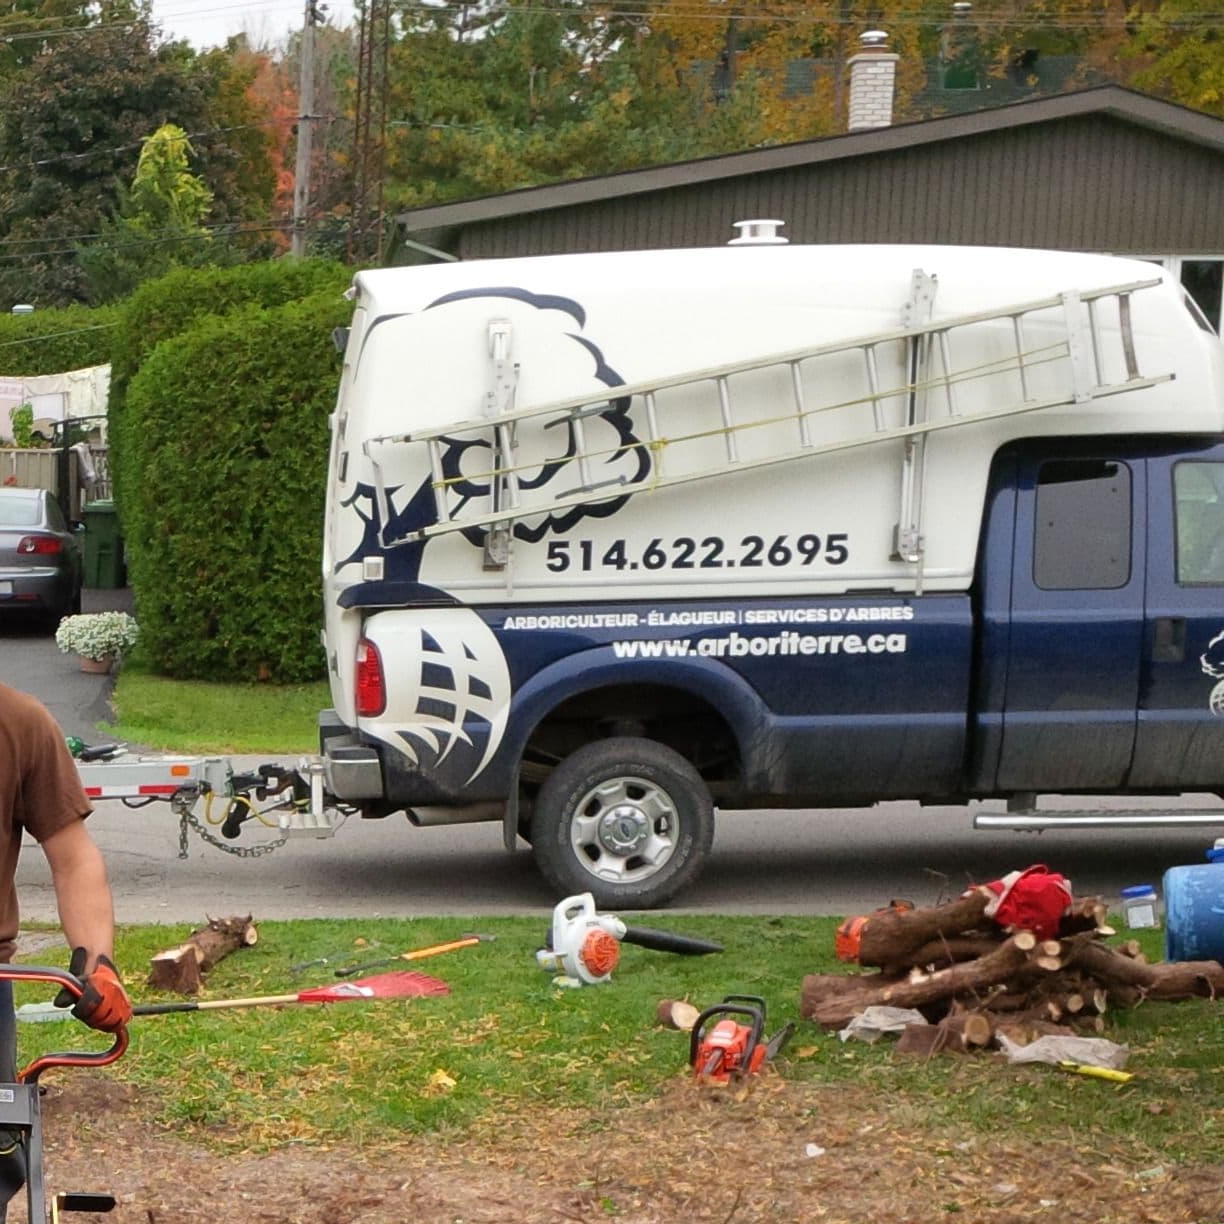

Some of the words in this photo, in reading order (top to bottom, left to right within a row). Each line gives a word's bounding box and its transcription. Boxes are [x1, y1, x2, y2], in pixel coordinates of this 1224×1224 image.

[546, 533, 849, 572] 514.622.2695
[745, 608, 827, 624] SERVICES
[829, 606, 914, 622] D'ARBRES
[612, 631, 907, 658] www.arboriterre.ca
